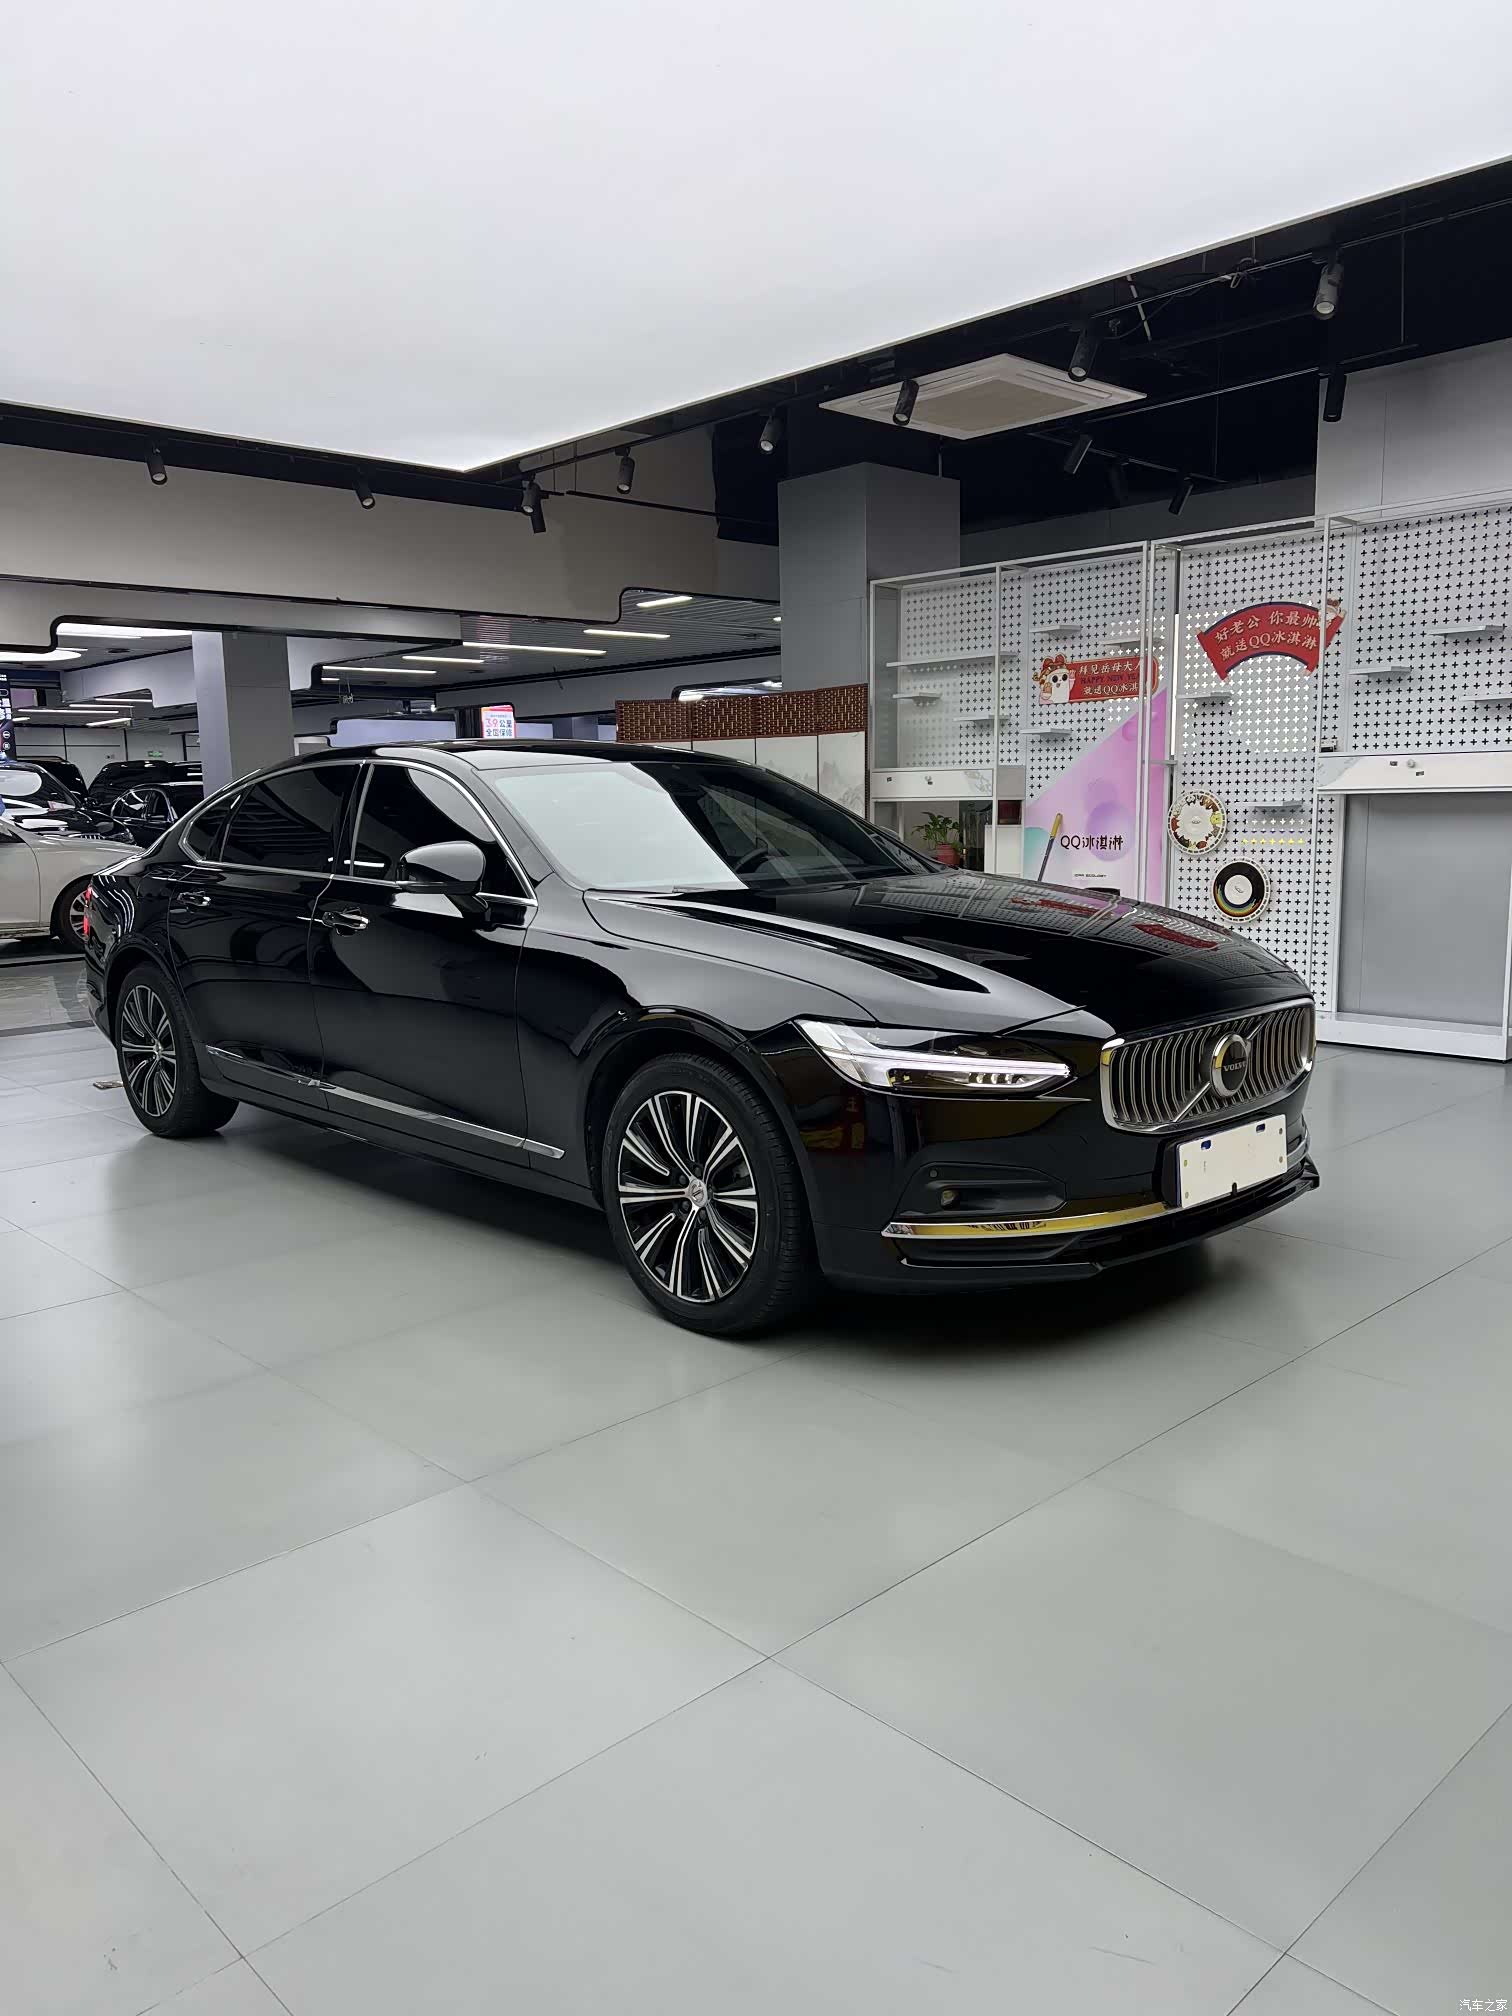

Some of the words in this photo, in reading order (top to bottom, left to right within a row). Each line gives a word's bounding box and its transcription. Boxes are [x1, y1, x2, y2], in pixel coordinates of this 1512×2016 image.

[1214, 614, 1261, 644] 好老公
[1268, 610, 1317, 629] 你最帅
[1220, 630, 1318, 660] 就送QQ冰淇淋
[1060, 834, 1124, 851] QQ冰淇淋
